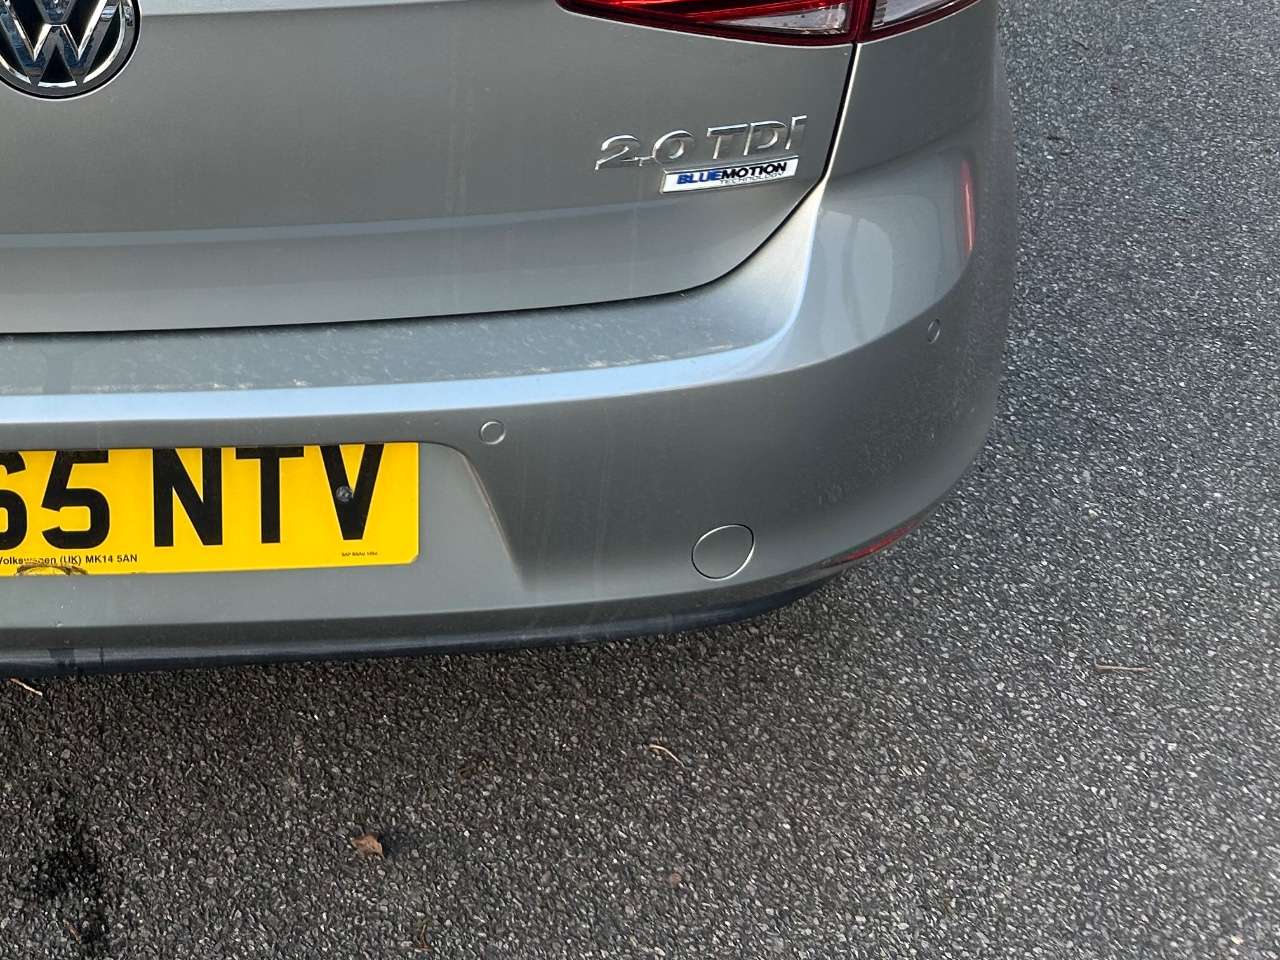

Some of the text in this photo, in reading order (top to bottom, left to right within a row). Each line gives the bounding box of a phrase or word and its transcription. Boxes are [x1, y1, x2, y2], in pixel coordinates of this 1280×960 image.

[594, 114, 808, 171] 2.0 TDI
[677, 161, 787, 185] BLUEMOTION
[152, 442, 385, 547] NTV
[60, 554, 82, 566] (UK)
[85, 554, 113, 563] MK14
[116, 554, 138, 562] 5AN
